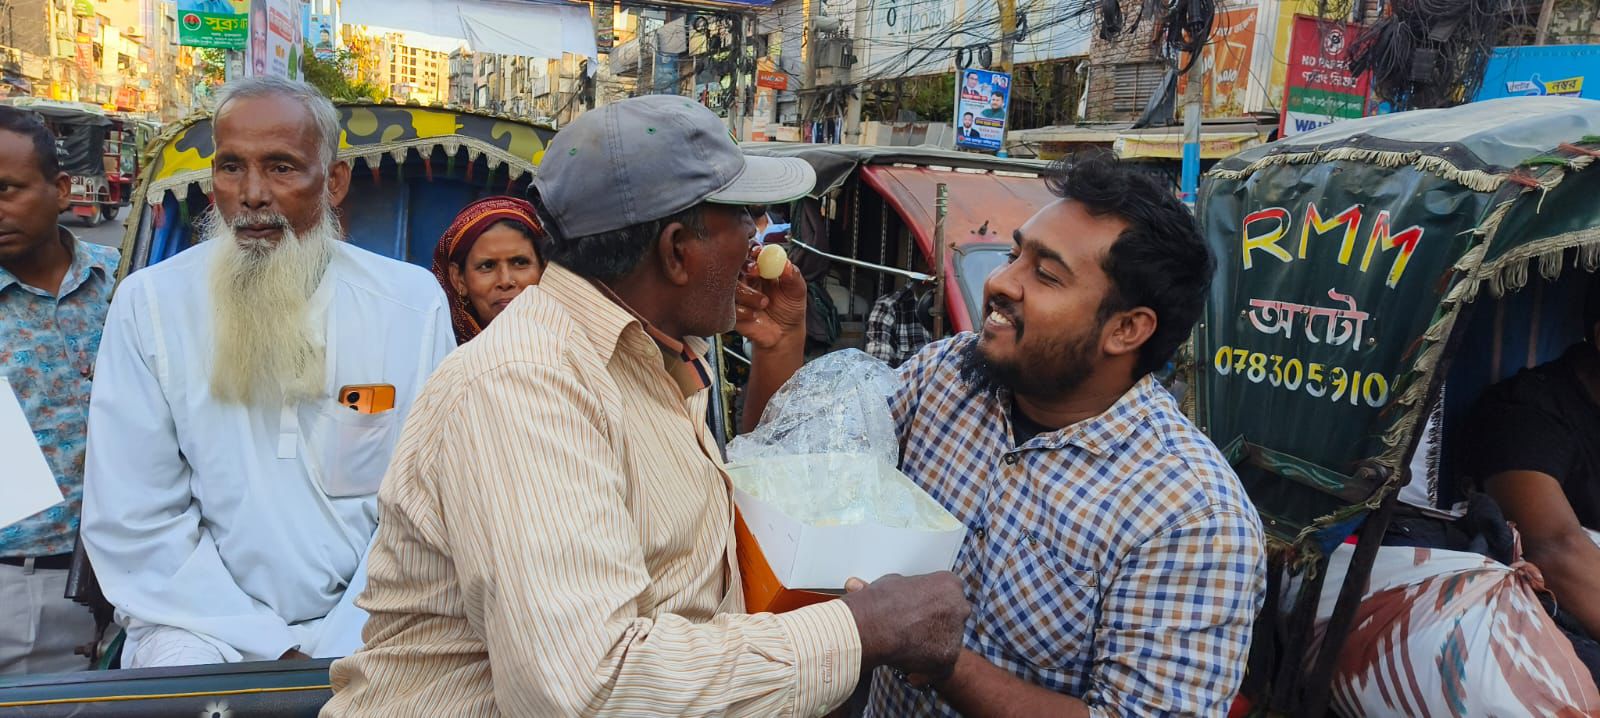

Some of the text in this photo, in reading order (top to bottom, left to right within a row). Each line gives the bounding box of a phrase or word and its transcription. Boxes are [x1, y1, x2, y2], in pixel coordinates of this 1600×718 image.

[1302, 55, 1316, 66] NO
[1242, 201, 1425, 289] RMM
[1248, 288, 1370, 351] অটো
